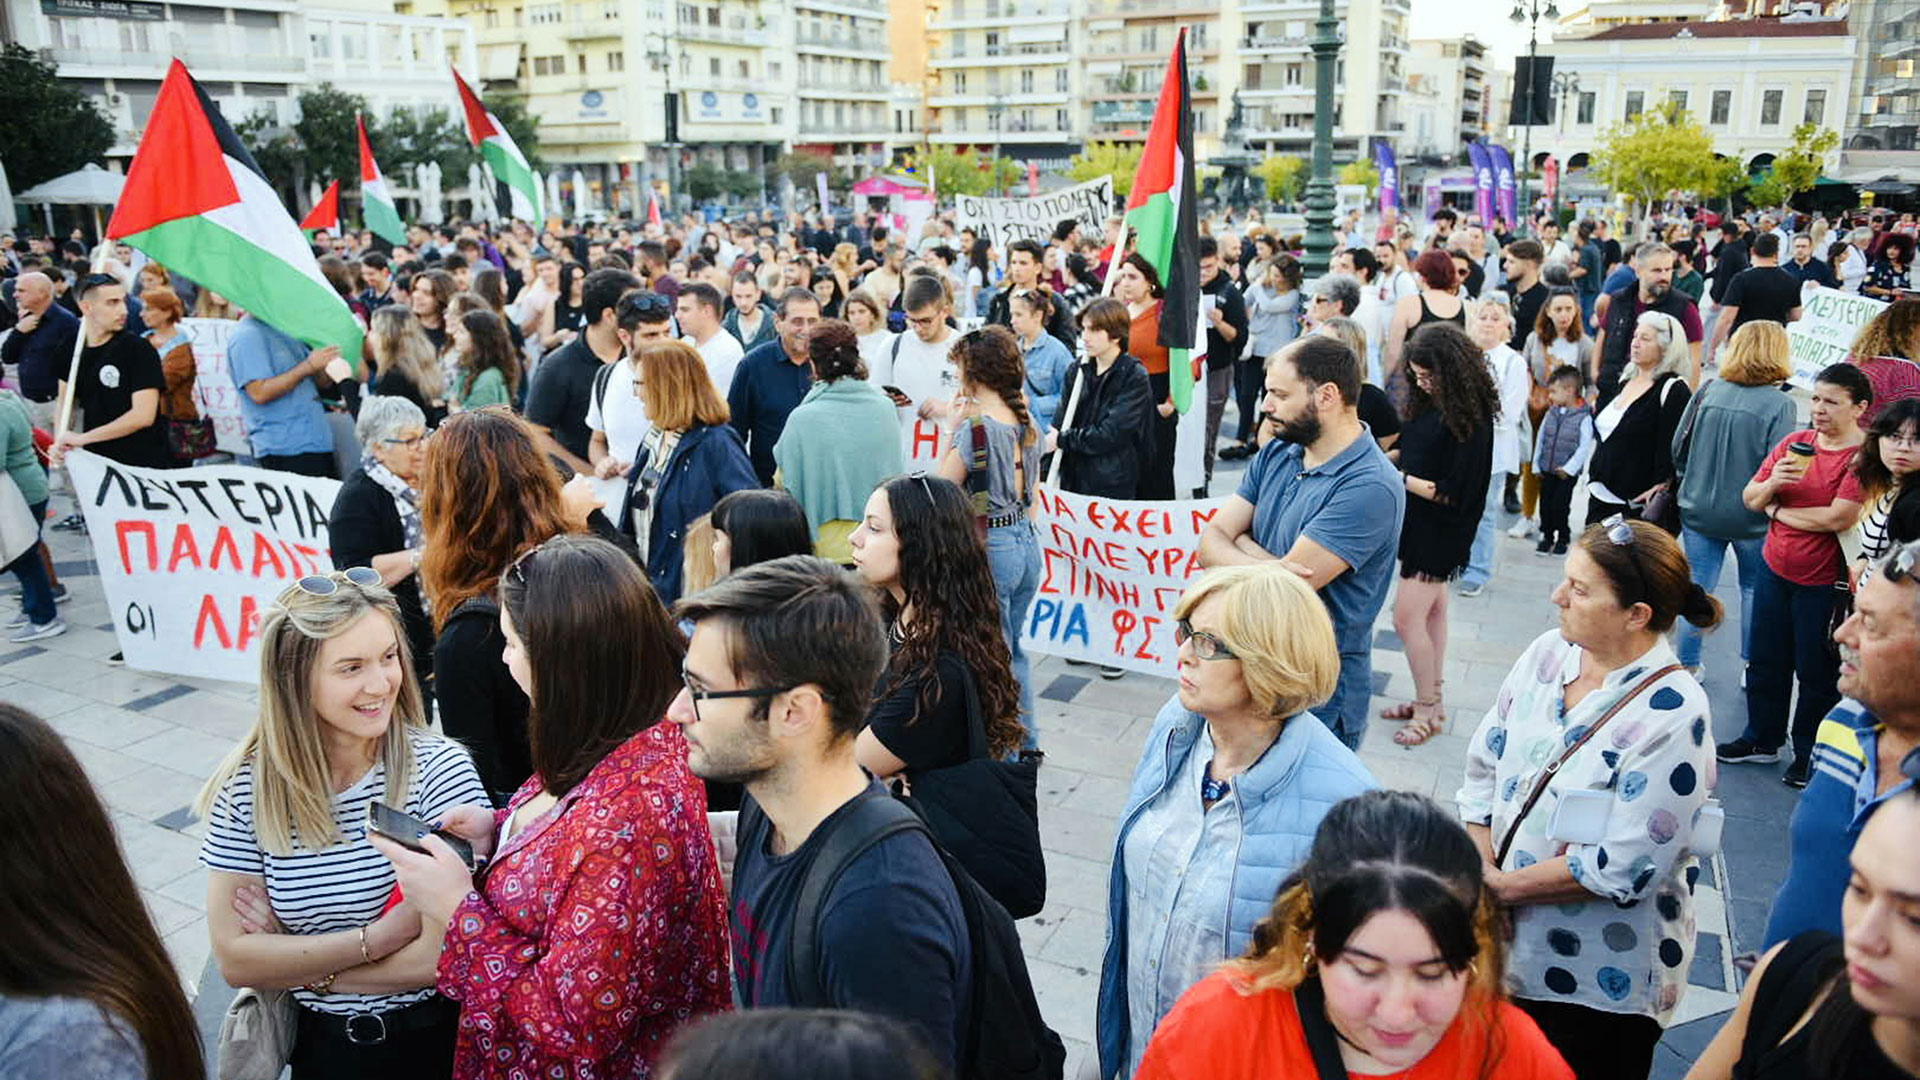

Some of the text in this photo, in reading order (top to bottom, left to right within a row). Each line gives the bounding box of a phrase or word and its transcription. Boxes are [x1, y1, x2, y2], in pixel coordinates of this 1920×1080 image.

[963, 198, 993, 219] ΟΧΙ
[1000, 199, 1041, 221] ΣΤΟ
[95, 464, 330, 539] ΛΕΥΤΕΡΙΑ
[1038, 488, 1077, 523] ΙΑ
[1087, 501, 1173, 538] ΕΧΕΙ
[1191, 507, 1219, 535] Μ
[1051, 523, 1206, 580] ΠΛΕΥΡΑ
[126, 601, 157, 641] ΟΙ
[1029, 598, 1089, 647] ΡΙΑ
